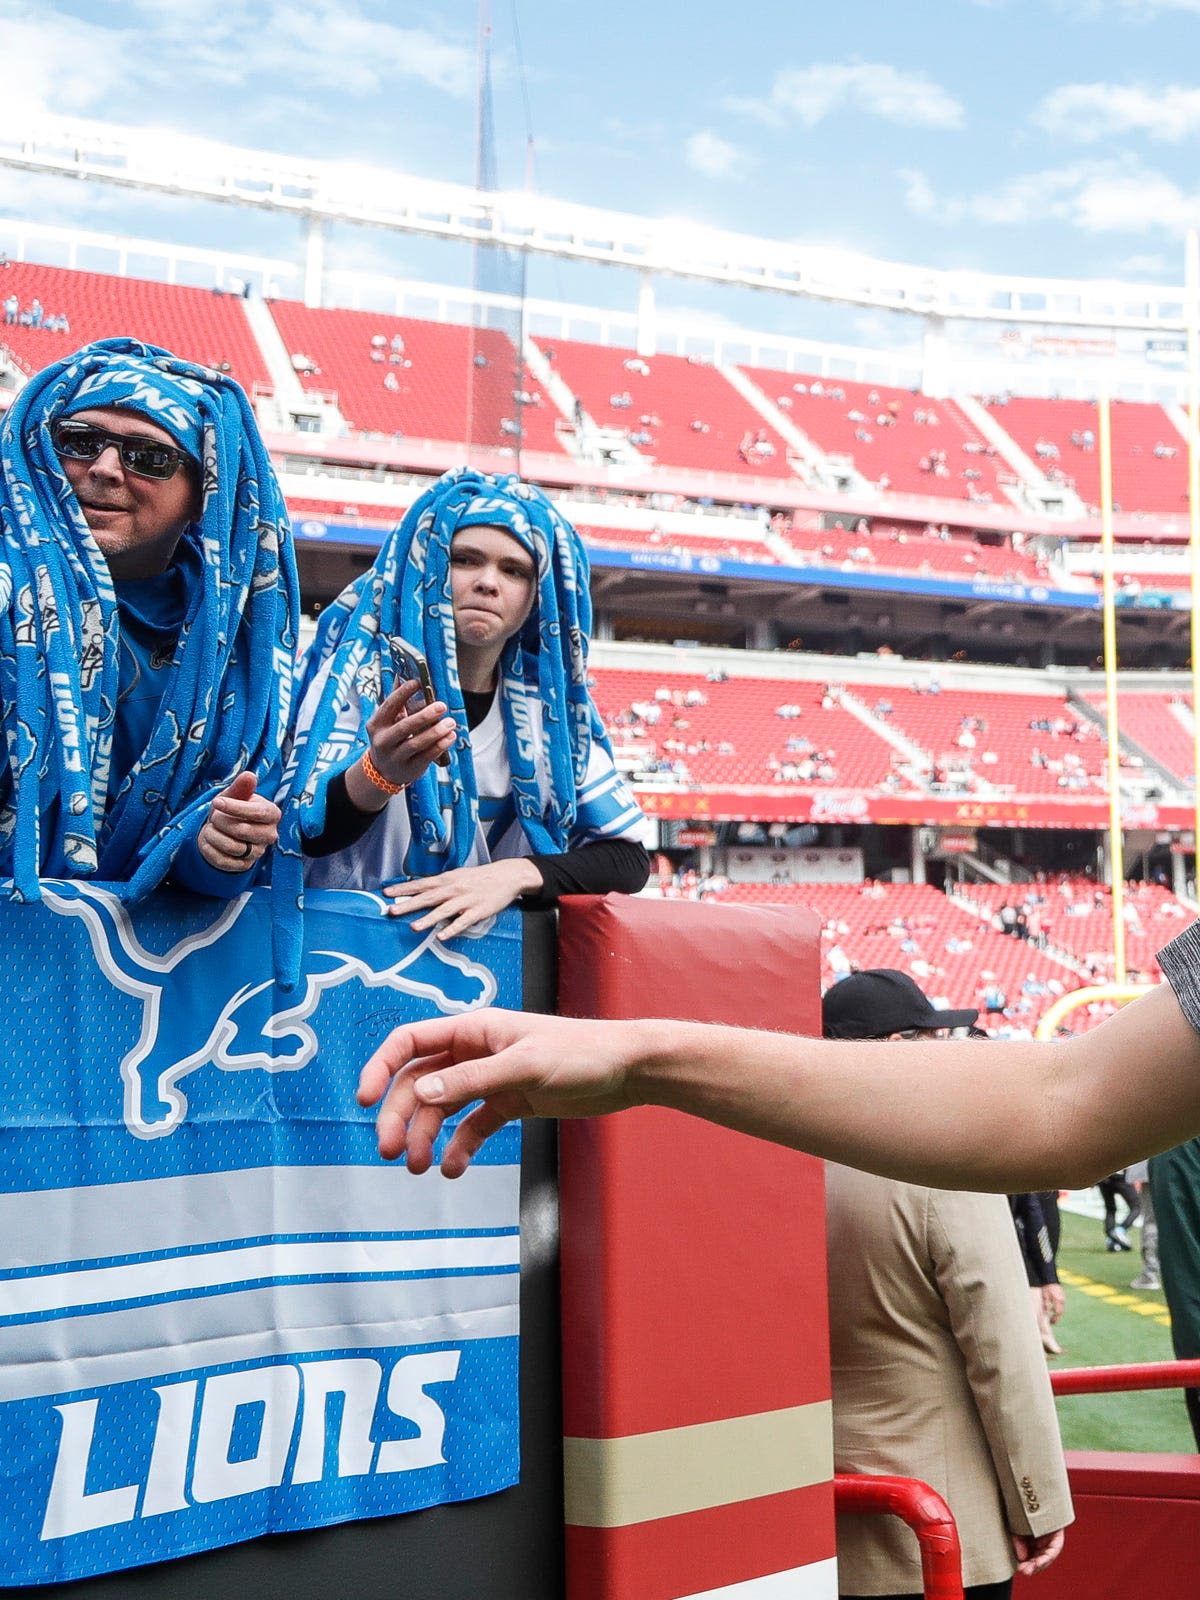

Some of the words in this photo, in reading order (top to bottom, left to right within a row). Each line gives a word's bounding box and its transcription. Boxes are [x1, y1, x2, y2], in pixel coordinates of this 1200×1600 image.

[50, 672, 86, 772] LIONS
[503, 678, 535, 763] LIONS
[40, 1350, 462, 1541] LIONS
